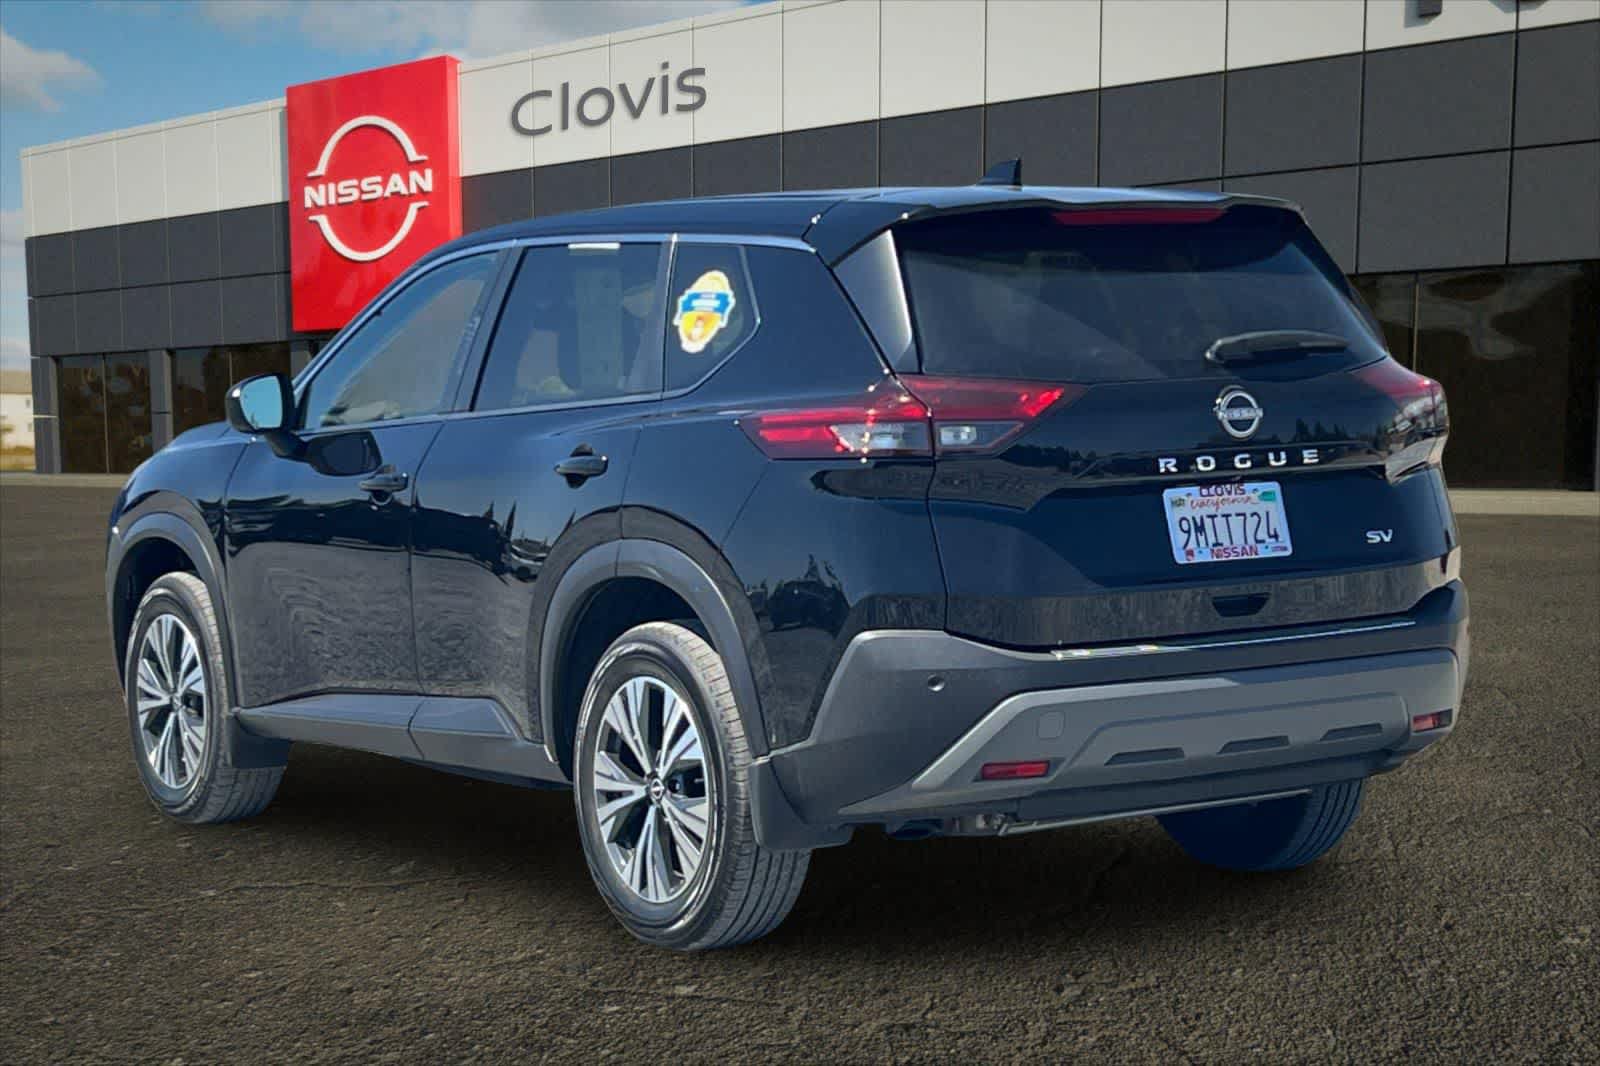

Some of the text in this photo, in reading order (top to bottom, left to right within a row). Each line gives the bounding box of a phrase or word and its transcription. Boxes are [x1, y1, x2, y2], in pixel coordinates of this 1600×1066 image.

[510, 62, 707, 136] Clovis
[303, 167, 433, 210] NISSAN
[1158, 448, 1320, 473] ROGUE
[1199, 483, 1246, 497] CLOVIS
[1178, 511, 1280, 550] 9MIT724
[1366, 528, 1393, 544] SV
[1210, 545, 1259, 559] NISSAN
